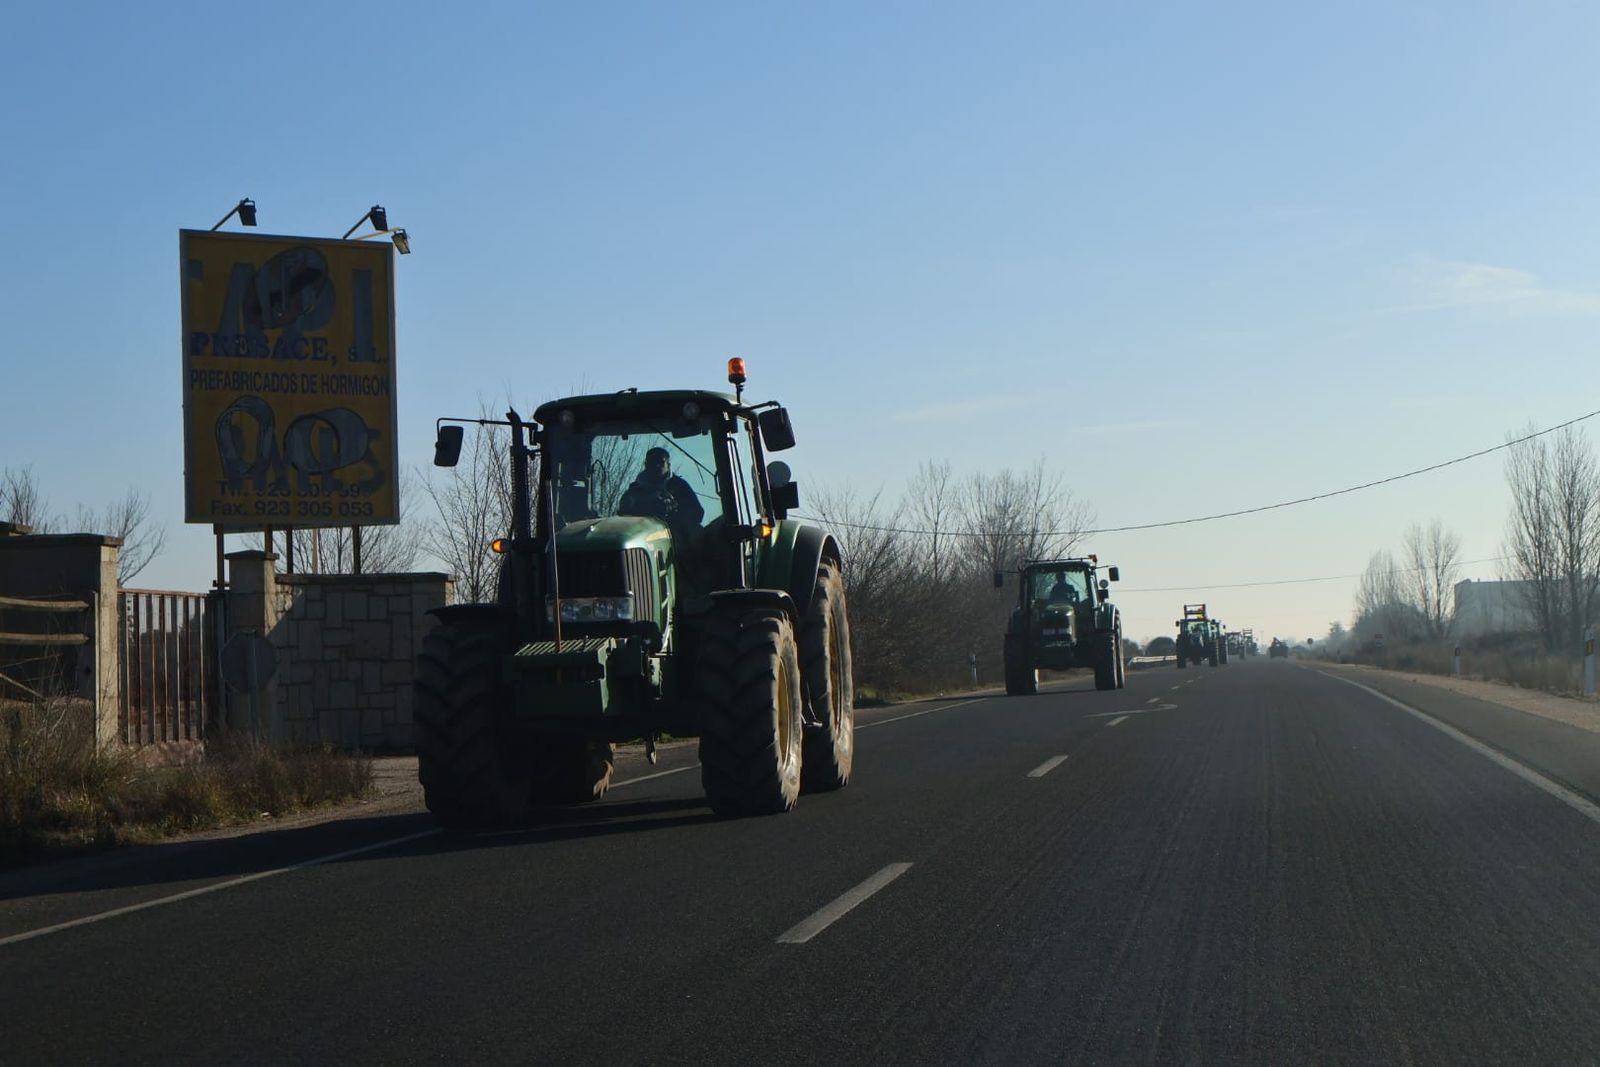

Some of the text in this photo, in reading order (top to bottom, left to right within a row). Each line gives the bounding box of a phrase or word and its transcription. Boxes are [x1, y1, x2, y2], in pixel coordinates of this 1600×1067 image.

[191, 369, 298, 394] PREFABRICADOS
[302, 374, 320, 393] DE
[211, 500, 374, 517] Fax. 923 305 053
